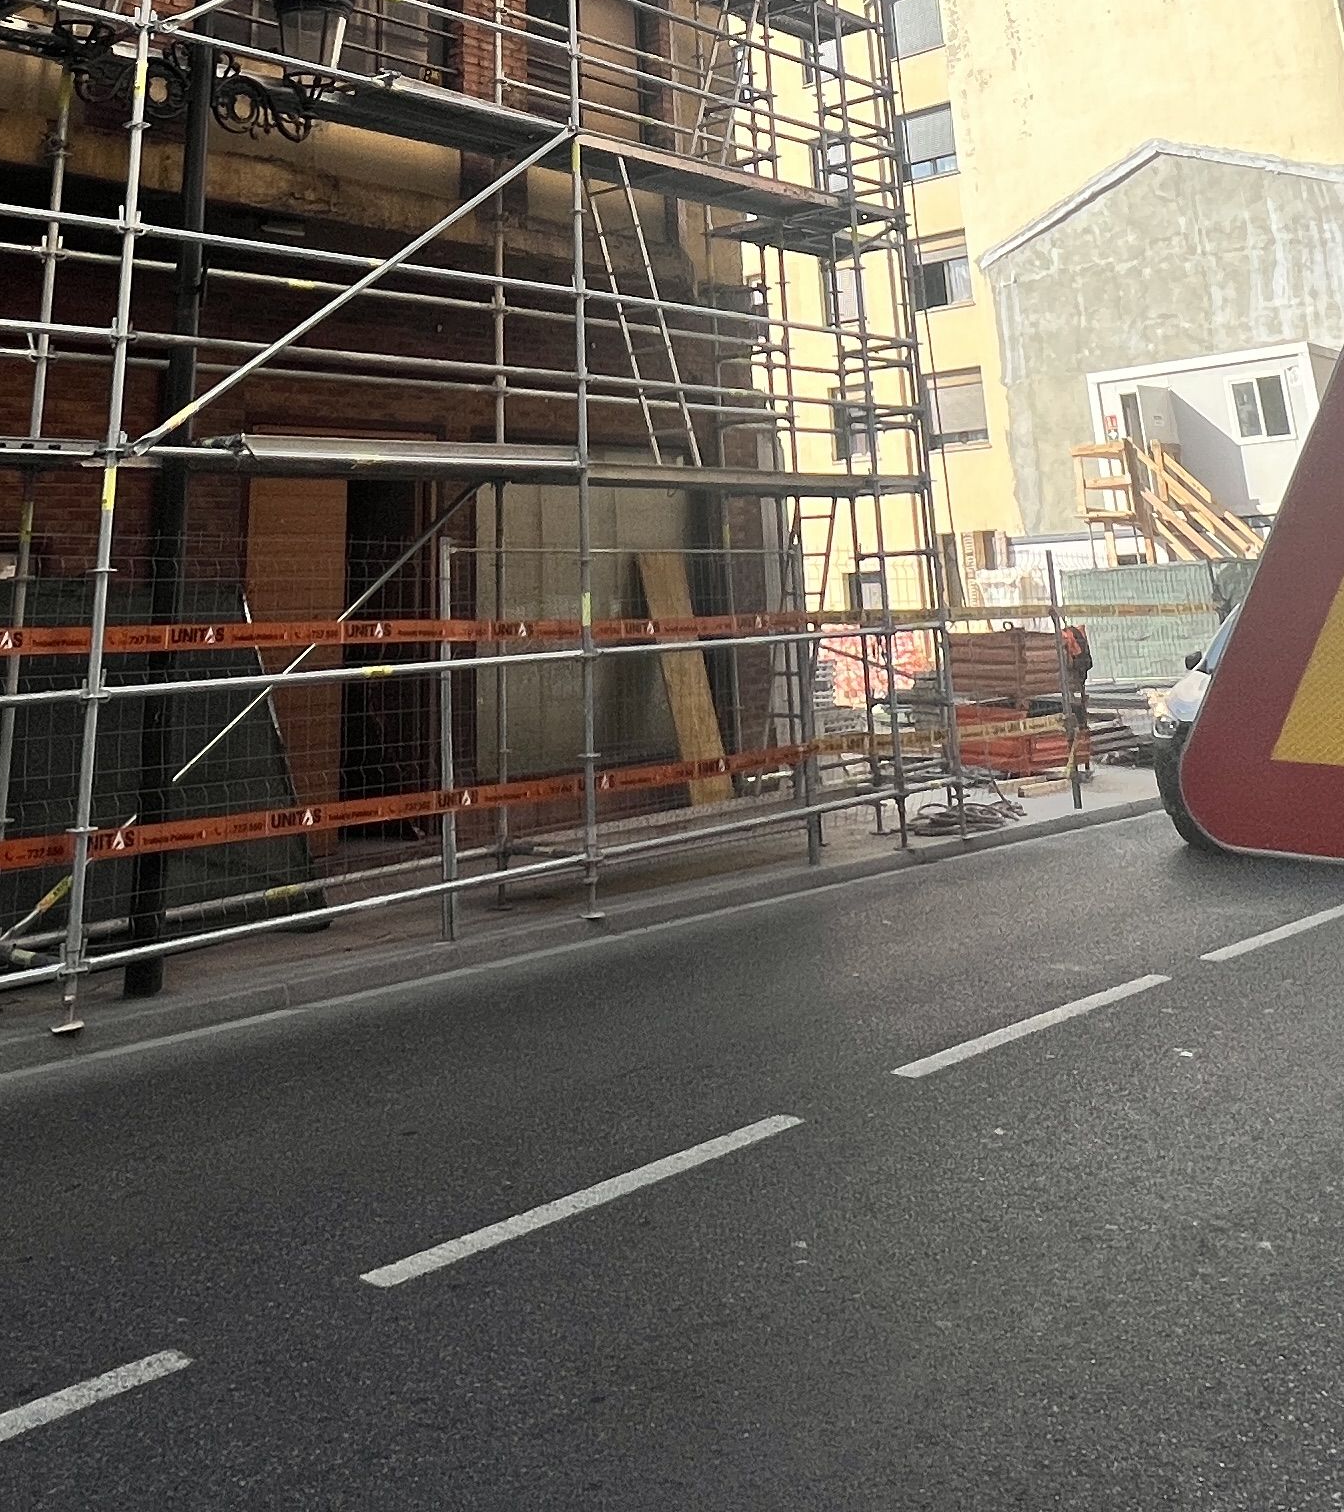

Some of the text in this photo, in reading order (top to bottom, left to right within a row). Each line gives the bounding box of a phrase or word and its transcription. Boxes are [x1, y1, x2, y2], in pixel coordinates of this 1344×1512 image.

[171, 626, 225, 645] UNITAS
[346, 622, 391, 639] UNITAS
[272, 808, 322, 830] UNITAS
[86, 830, 136, 852] NITAS
